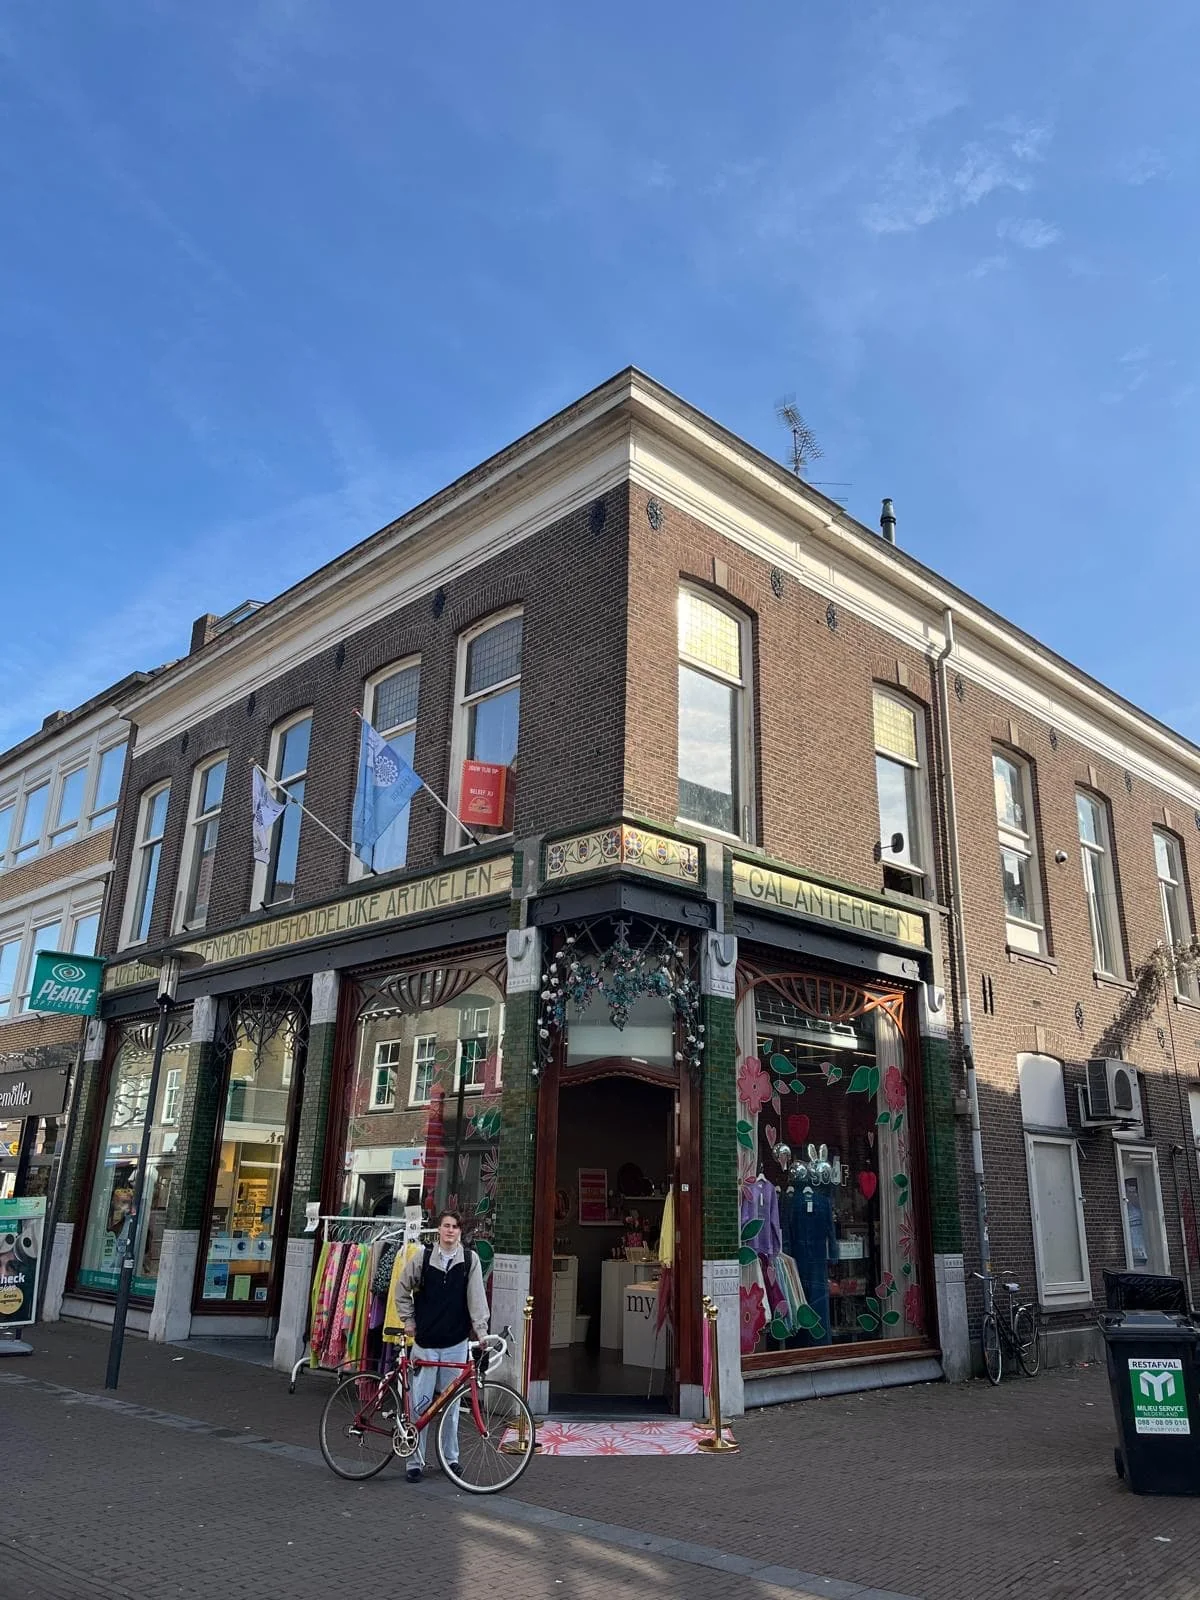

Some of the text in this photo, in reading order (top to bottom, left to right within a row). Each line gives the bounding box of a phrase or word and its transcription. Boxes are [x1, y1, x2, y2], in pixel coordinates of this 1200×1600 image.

[385, 864, 492, 919] ARTIKELEN
[37, 979, 96, 1005] PEARLE
[627, 1294, 656, 1319] my
[1132, 1361, 1178, 1369] RESTAFVAL
